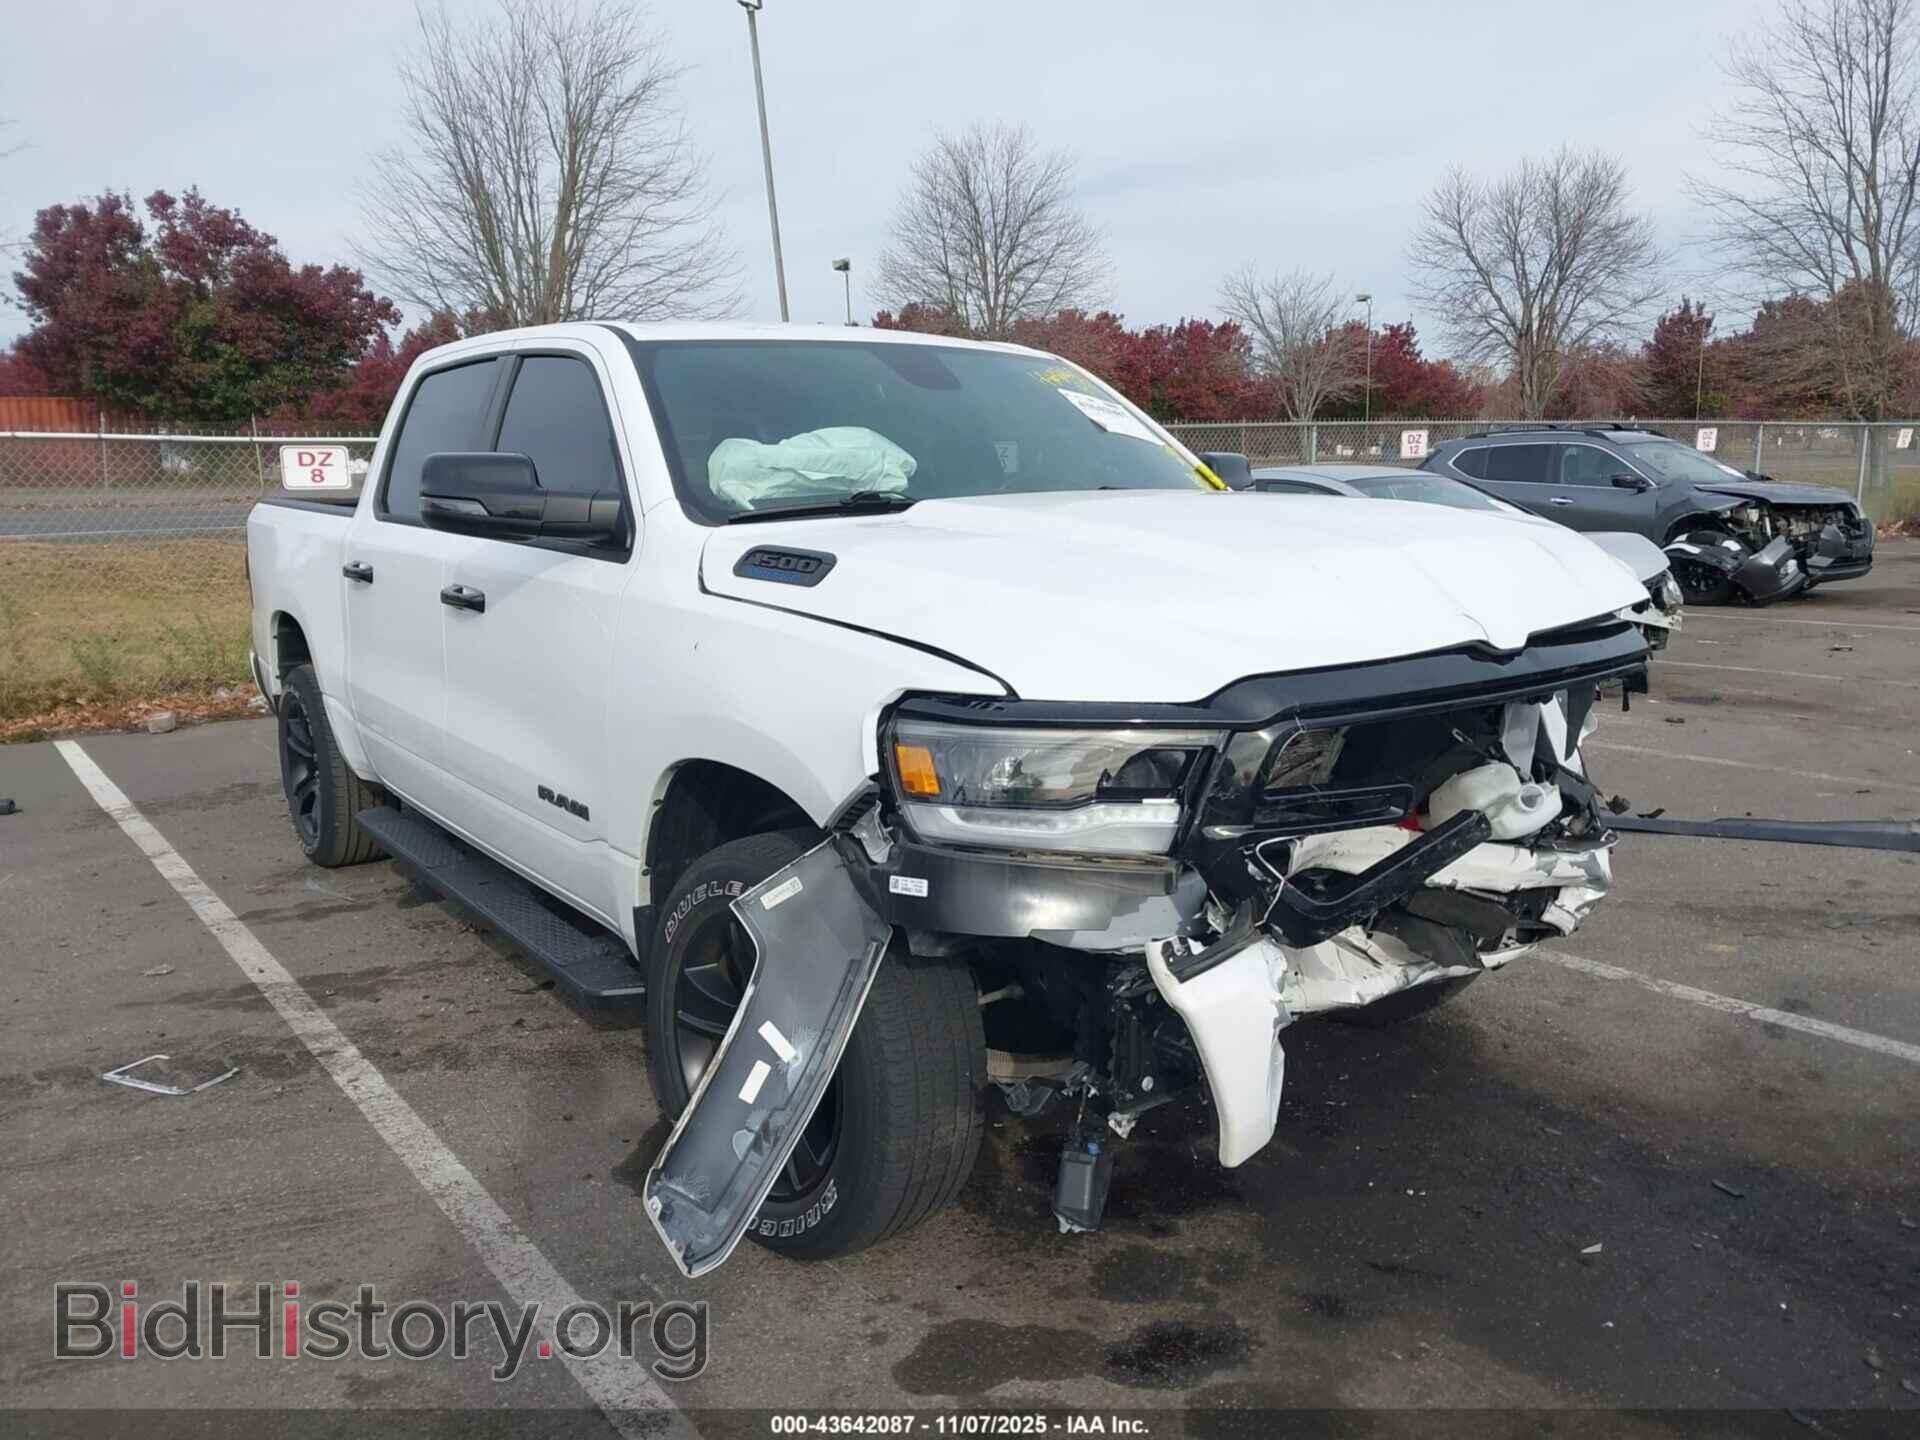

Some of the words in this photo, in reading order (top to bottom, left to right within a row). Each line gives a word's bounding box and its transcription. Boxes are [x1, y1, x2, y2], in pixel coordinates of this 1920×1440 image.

[1408, 434, 1422, 444] DZ
[1409, 445, 1420, 454] 12
[298, 452, 334, 467] DZ
[311, 469, 325, 483] 8
[743, 551, 822, 573] 1500
[538, 784, 590, 822] RAM
[665, 880, 745, 943] DUELE
